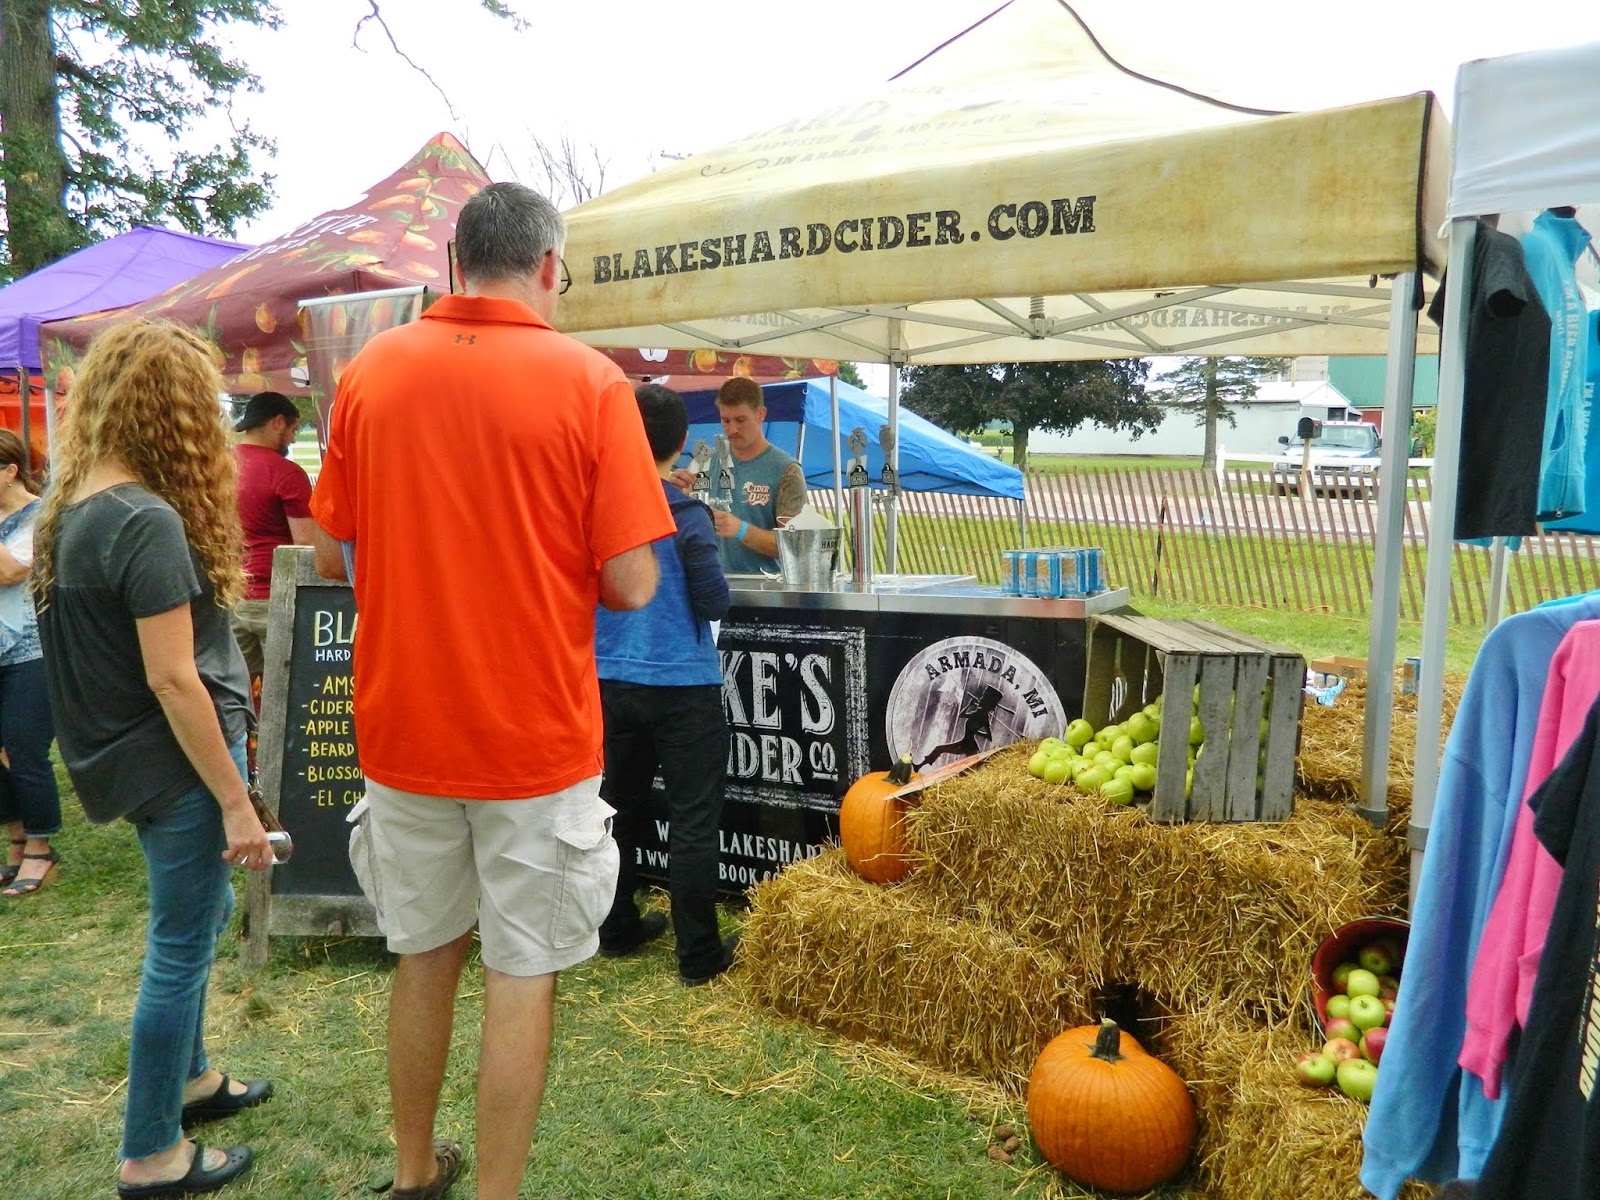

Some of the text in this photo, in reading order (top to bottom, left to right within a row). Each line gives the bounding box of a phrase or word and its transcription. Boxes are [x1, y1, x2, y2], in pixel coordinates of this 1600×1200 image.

[592, 195, 1098, 286] BLAKESHARDCIDER.COM
[747, 484, 770, 493] CIDER
[315, 649, 351, 662] HARD
[925, 650, 1049, 719] ARMADA, MI
[808, 741, 839, 774] CO.
[343, 790, 365, 805] CH
